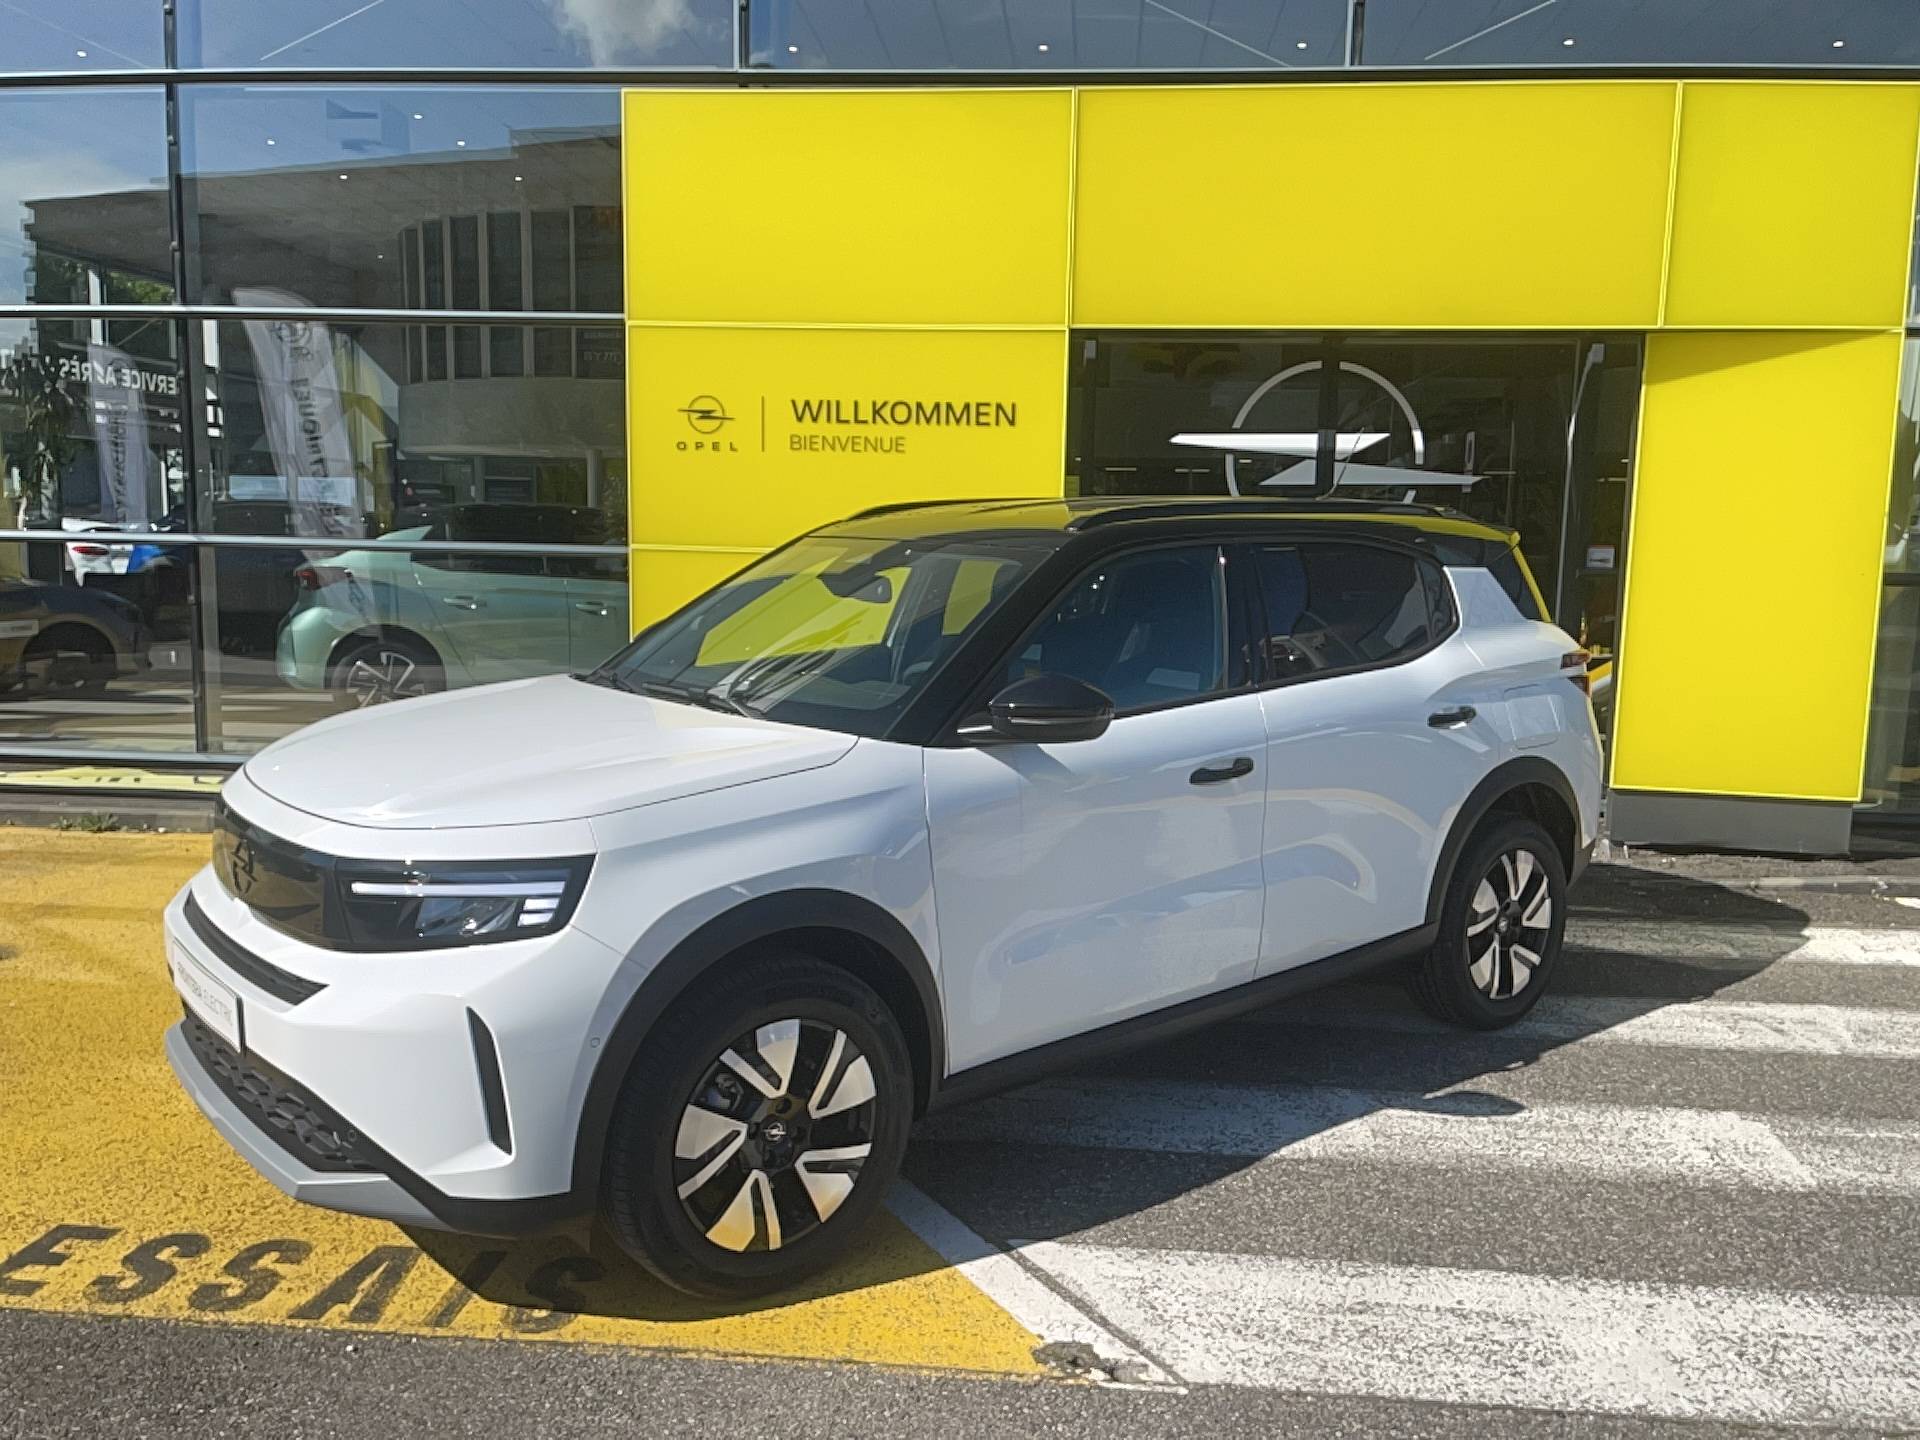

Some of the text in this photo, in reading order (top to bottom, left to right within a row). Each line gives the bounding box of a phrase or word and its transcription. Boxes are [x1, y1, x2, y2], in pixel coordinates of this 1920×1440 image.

[790, 399, 1016, 426] WILLKOMMEN
[676, 440, 738, 452] OPEL
[789, 434, 905, 453] BIENVENUE
[0, 1223, 599, 1333] ESSAIS
